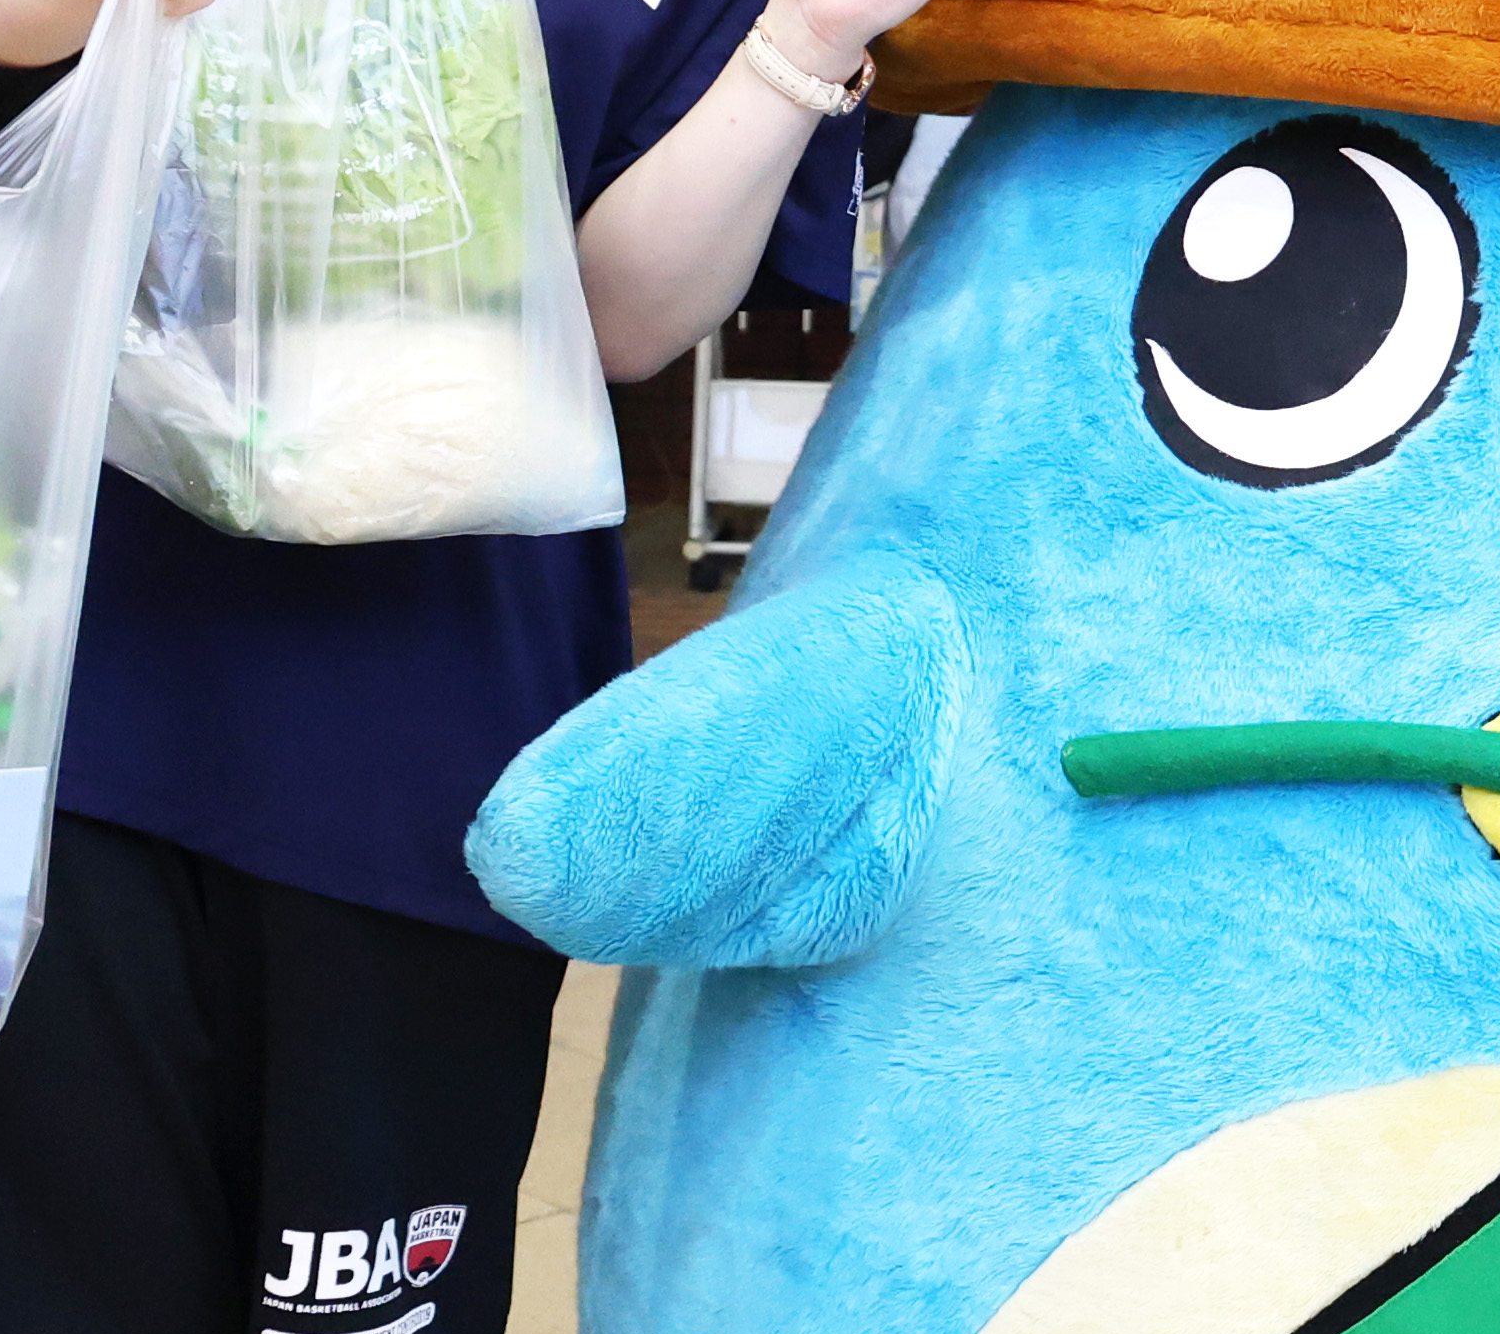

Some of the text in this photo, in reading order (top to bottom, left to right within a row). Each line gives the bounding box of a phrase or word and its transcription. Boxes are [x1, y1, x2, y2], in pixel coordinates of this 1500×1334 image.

[412, 1210, 461, 1232] JAPAN
[264, 1218, 401, 1300] JBA
[262, 1296, 294, 1312] JAPAN
[296, 1301, 360, 1314] BASKETBALL
